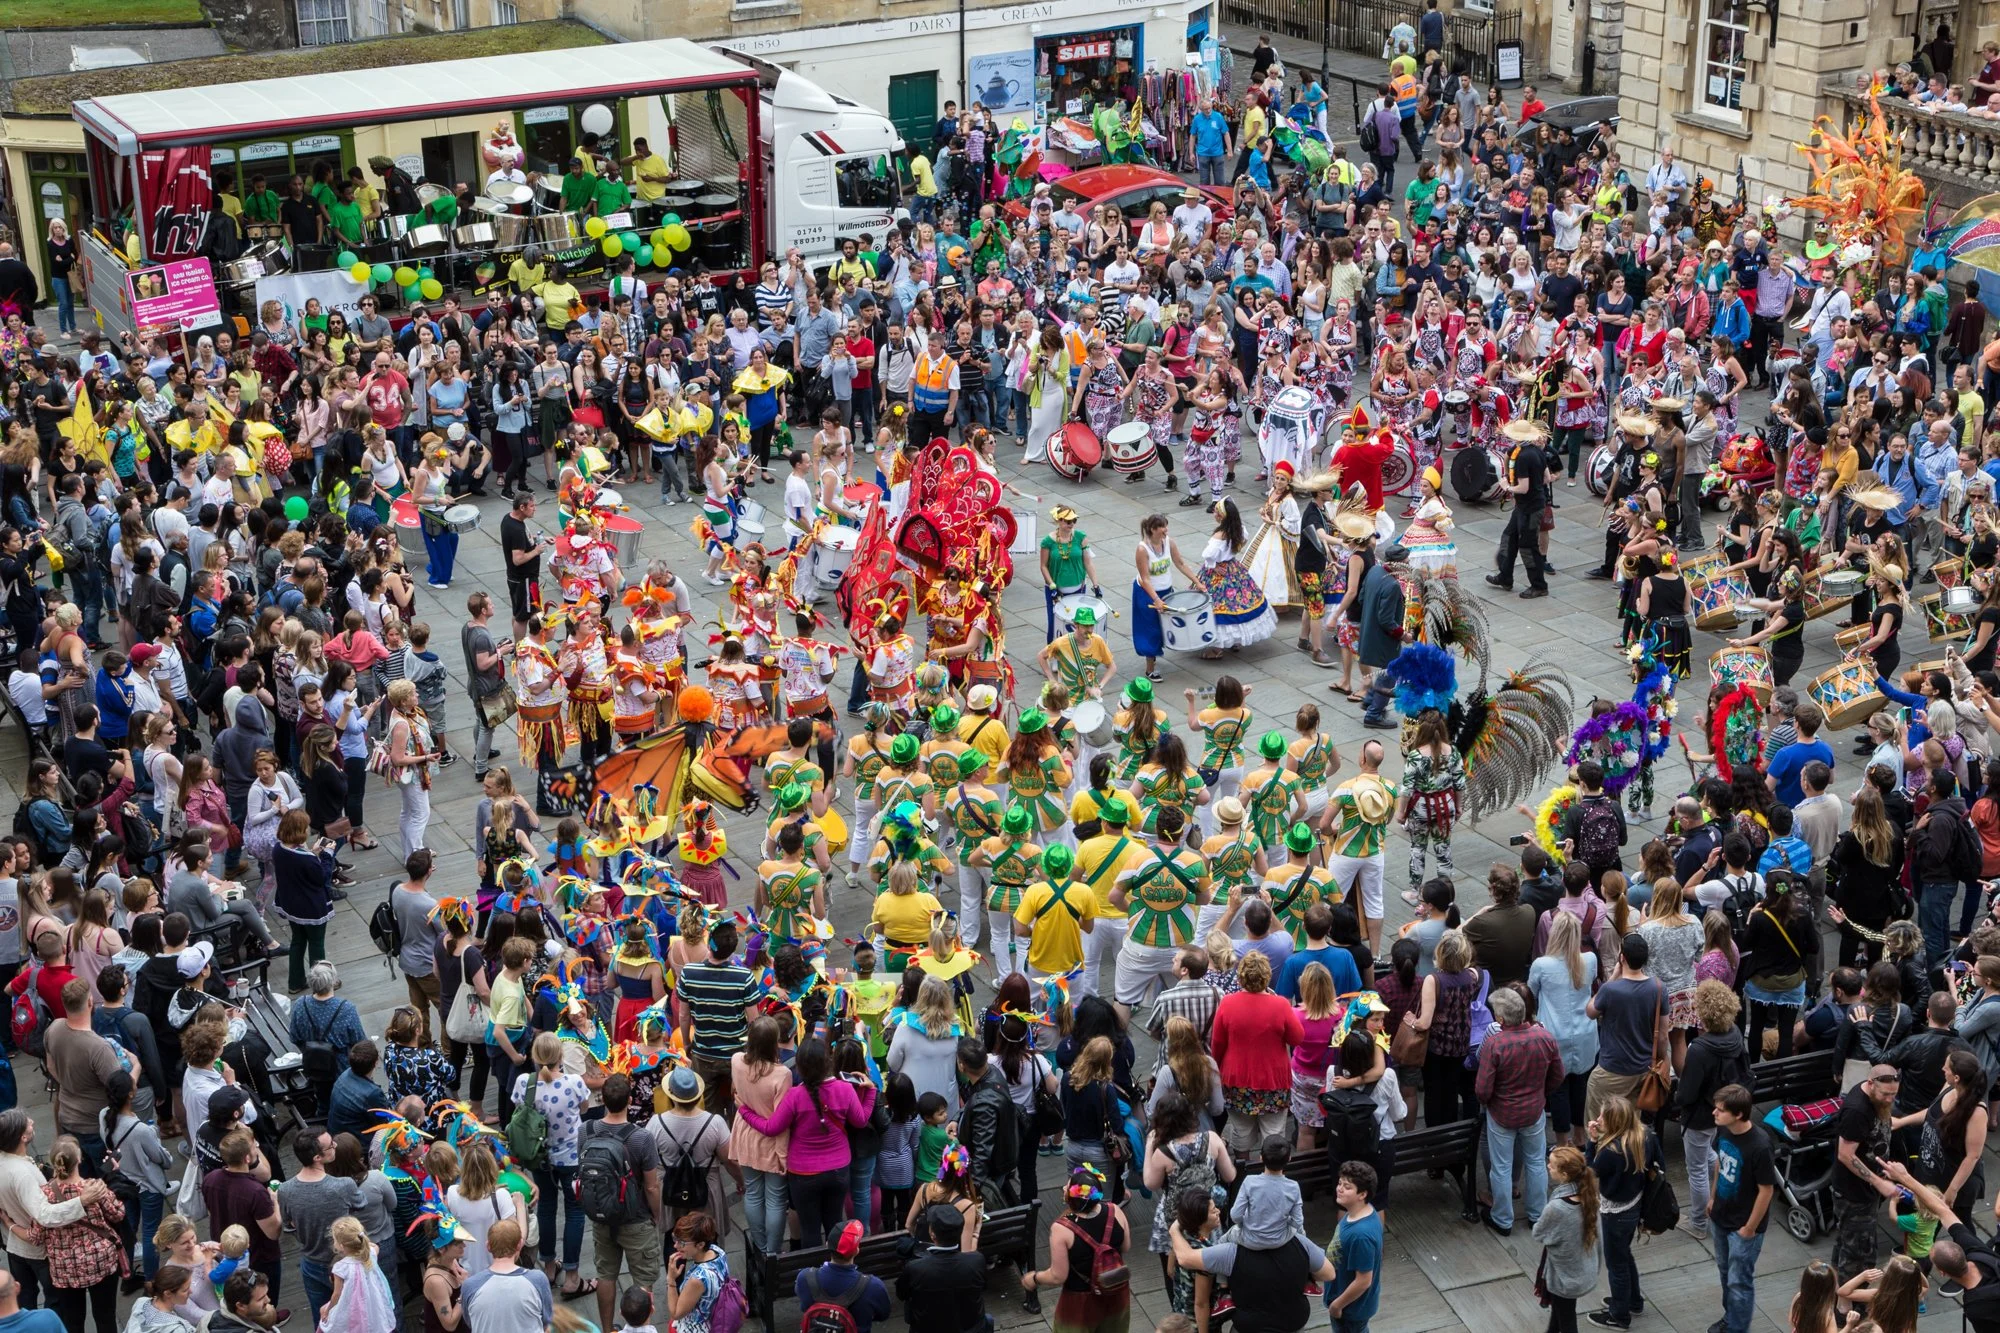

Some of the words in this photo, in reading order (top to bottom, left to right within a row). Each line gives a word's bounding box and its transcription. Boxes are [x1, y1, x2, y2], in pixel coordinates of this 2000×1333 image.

[754, 39, 780, 49] 1850
[909, 17, 953, 33] DAIRY
[1002, 5, 1052, 21] CREAM
[1060, 43, 1109, 60] SALE
[796, 227, 822, 236] 01749
[838, 219, 888, 232] WillmottsDJB
[793, 236, 826, 246] 880333
[500, 251, 556, 264] Caran
[557, 244, 596, 261] Kitchen
[370, 382, 400, 412] 34
[1150, 872, 1174, 887] OLA
[1143, 887, 1183, 902] SAMBA
